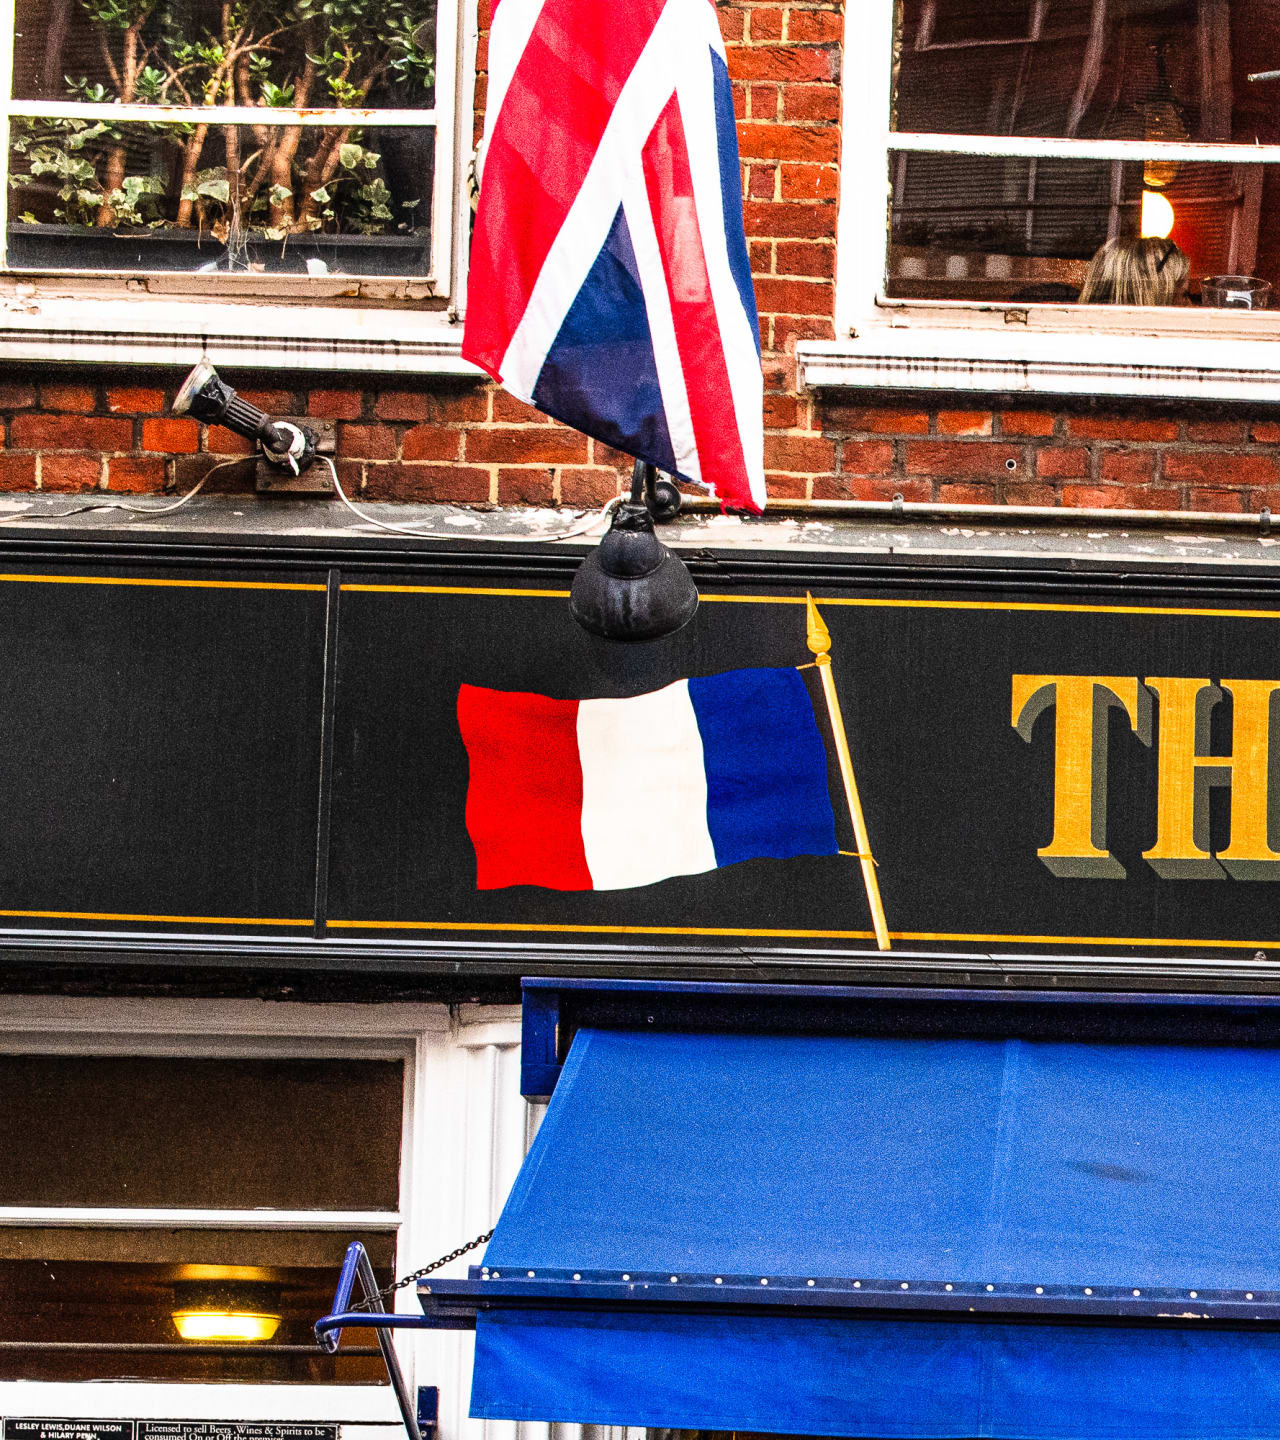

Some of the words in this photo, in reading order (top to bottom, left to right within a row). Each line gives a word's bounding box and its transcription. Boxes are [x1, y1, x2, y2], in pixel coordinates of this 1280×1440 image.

[15, 1422, 40, 1430] LESLEY
[92, 1424, 122, 1432] WILSON
[145, 1423, 181, 1433] Licensed
[194, 1424, 207, 1433] sell
[209, 1425, 232, 1434] Beers
[264, 1426, 273, 1435] &
[275, 1426, 302, 1437] Spirits
[315, 1427, 325, 1436] be
